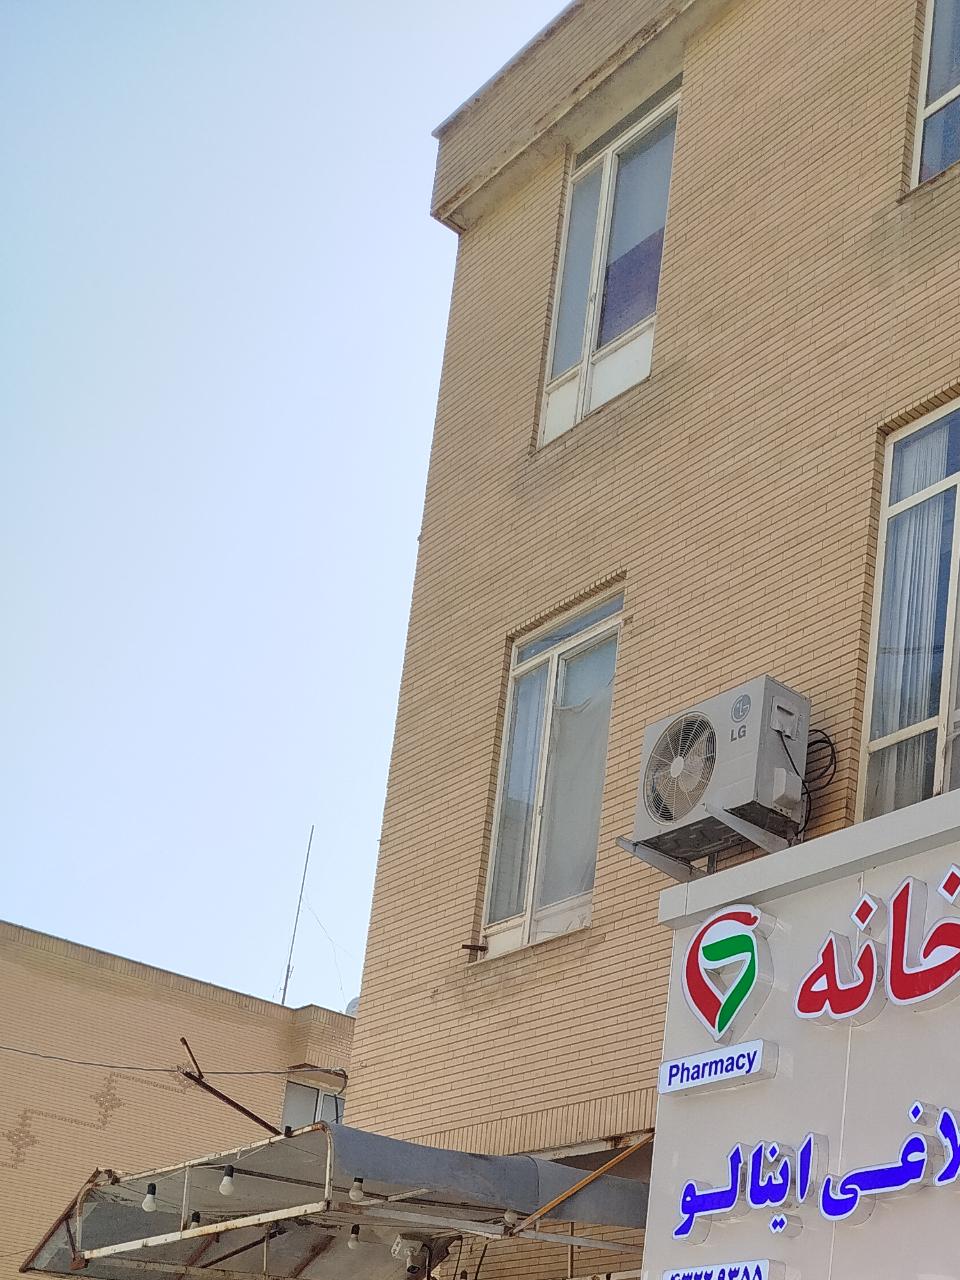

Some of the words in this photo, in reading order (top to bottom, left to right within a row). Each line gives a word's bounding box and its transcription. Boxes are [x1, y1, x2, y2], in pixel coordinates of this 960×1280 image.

[730, 725, 747, 743] LG
[667, 1049, 758, 1086] Pharmacy
[674, 1136, 811, 1238] اینالو
